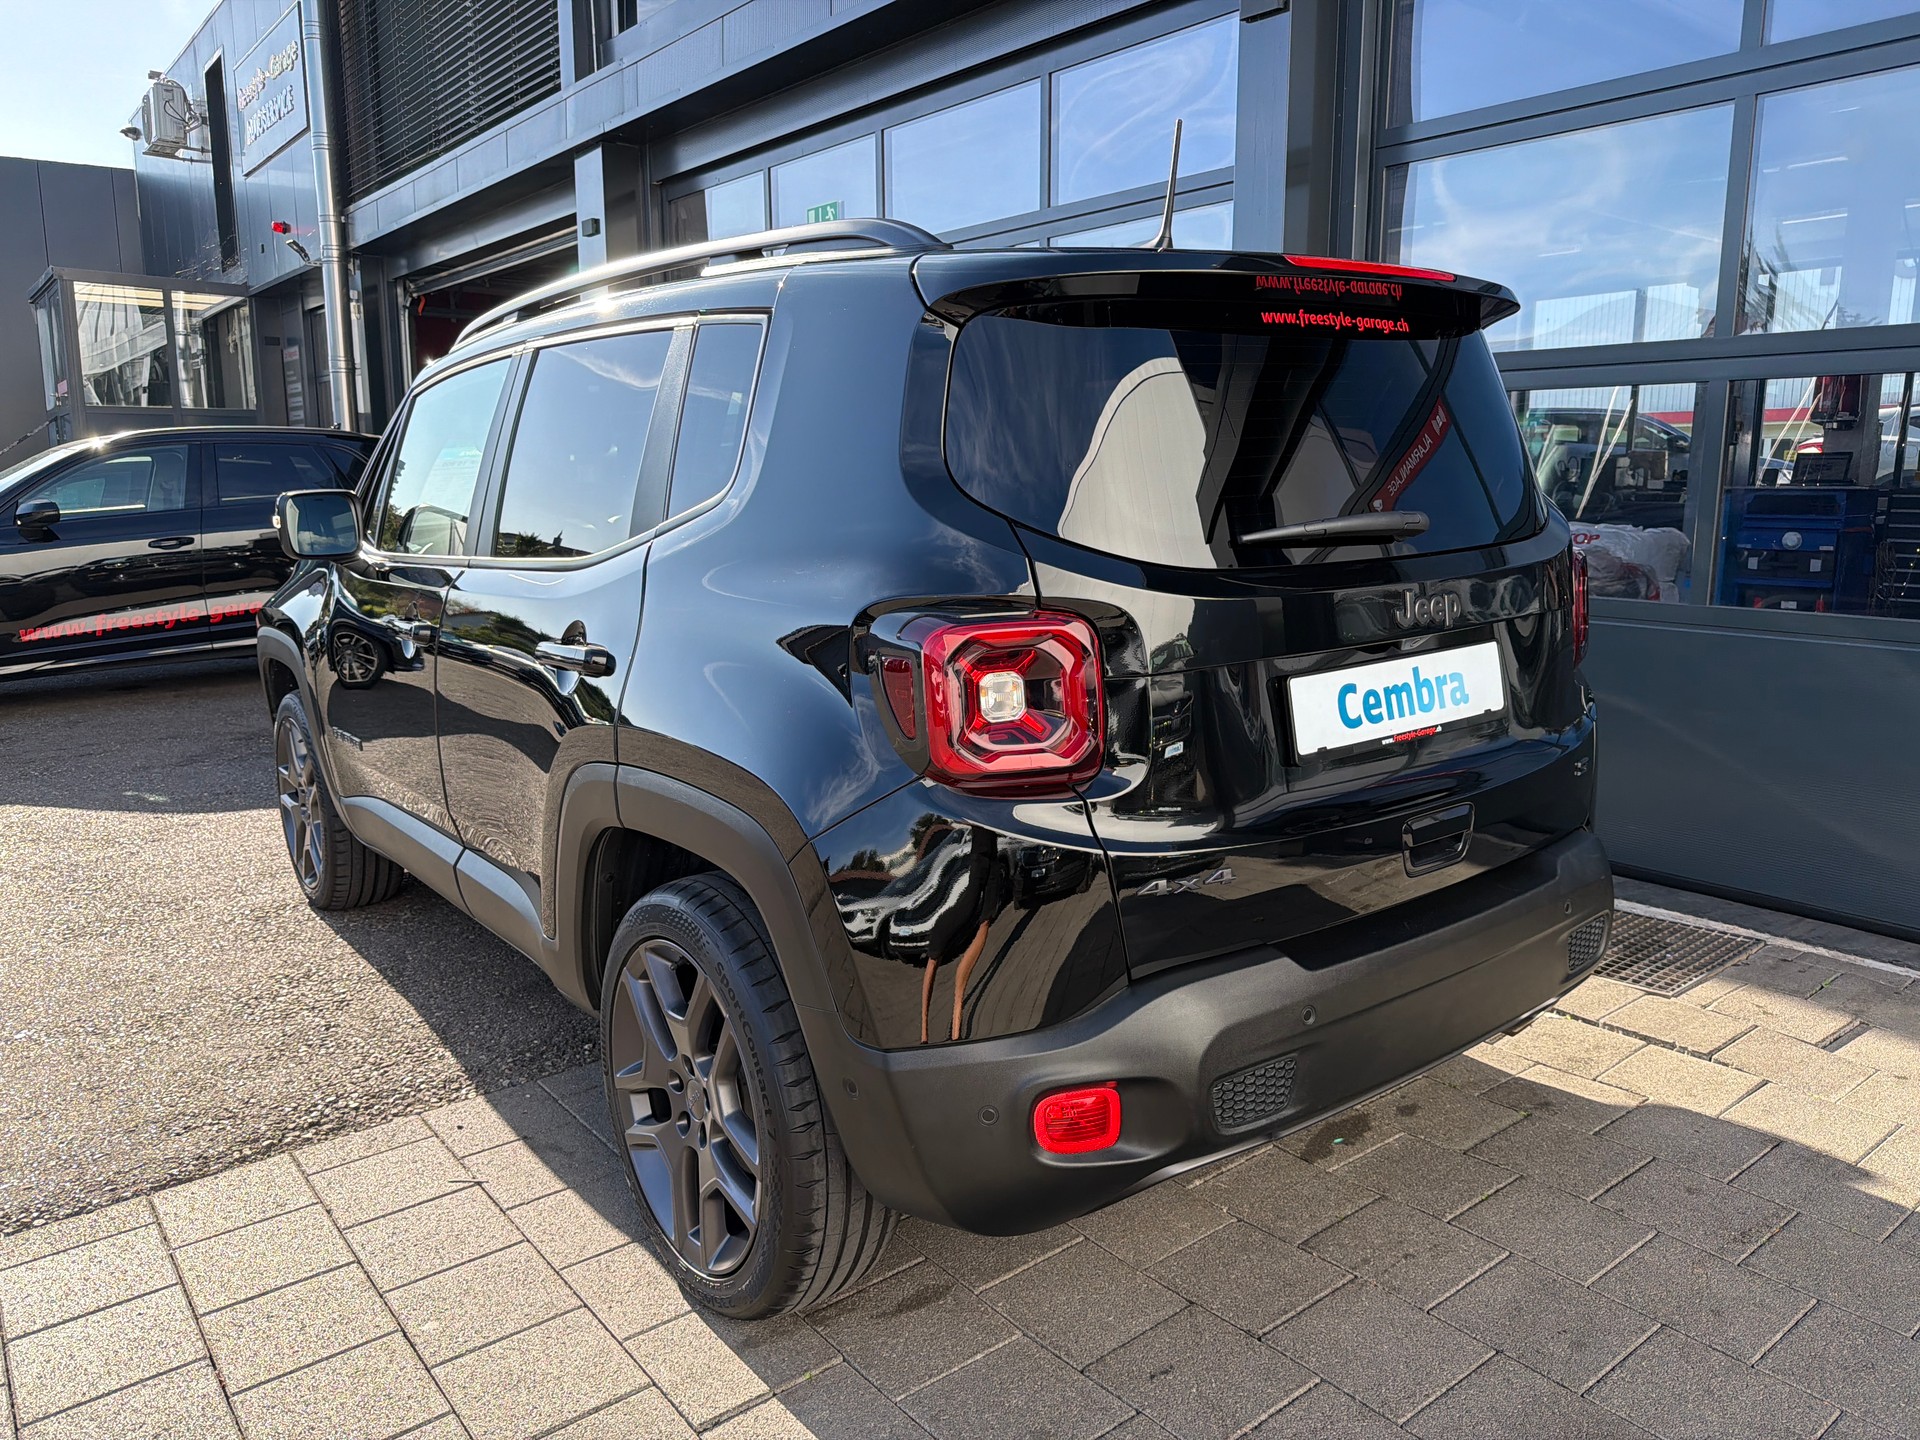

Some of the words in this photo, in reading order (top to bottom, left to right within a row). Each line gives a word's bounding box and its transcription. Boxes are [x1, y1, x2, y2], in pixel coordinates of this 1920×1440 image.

[1261, 309, 1410, 334] www.freestyle-garage.ch
[1571, 532, 1601, 545] OP
[1394, 588, 1463, 630] Jeep
[1337, 665, 1470, 730] Cembra
[715, 961, 772, 1118] SportContact
